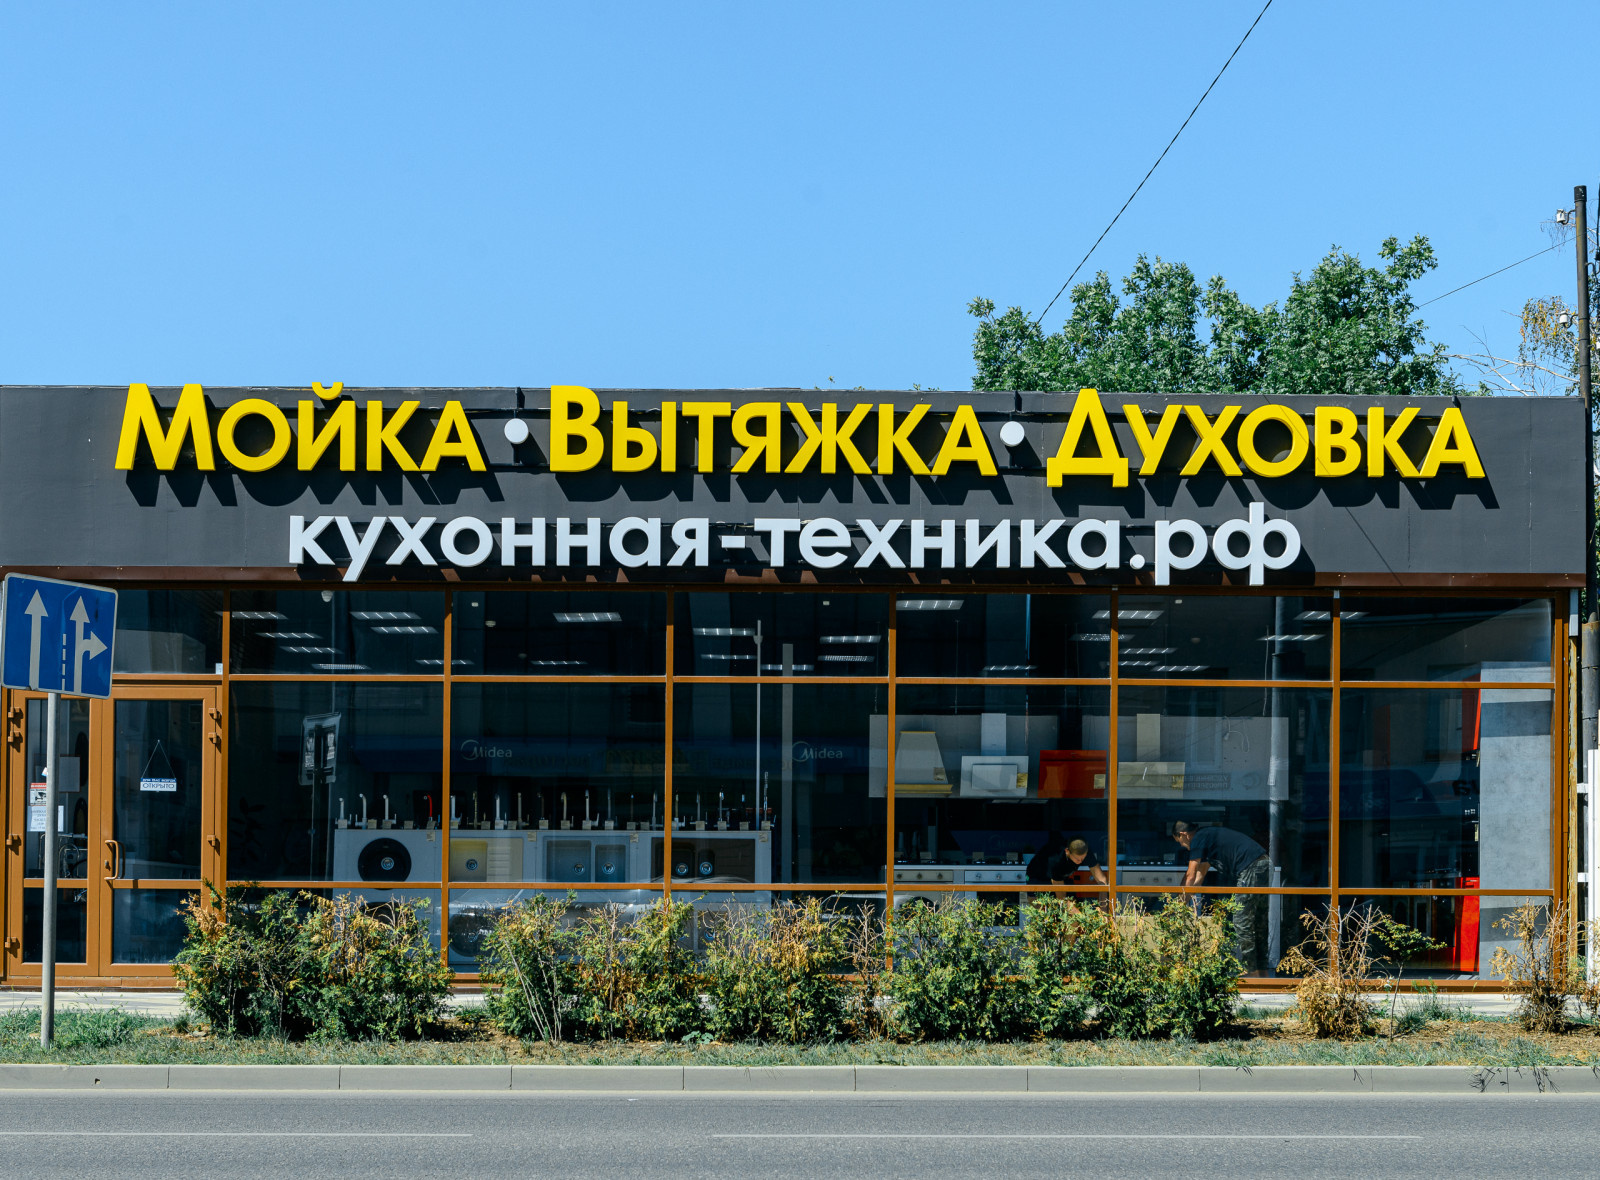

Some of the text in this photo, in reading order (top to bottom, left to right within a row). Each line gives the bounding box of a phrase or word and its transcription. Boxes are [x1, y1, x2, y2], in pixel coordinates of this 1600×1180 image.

[288, 500, 1302, 587] кухонная-техника.рф
[466, 744, 513, 760] Midea
[796, 745, 843, 761] Midea
